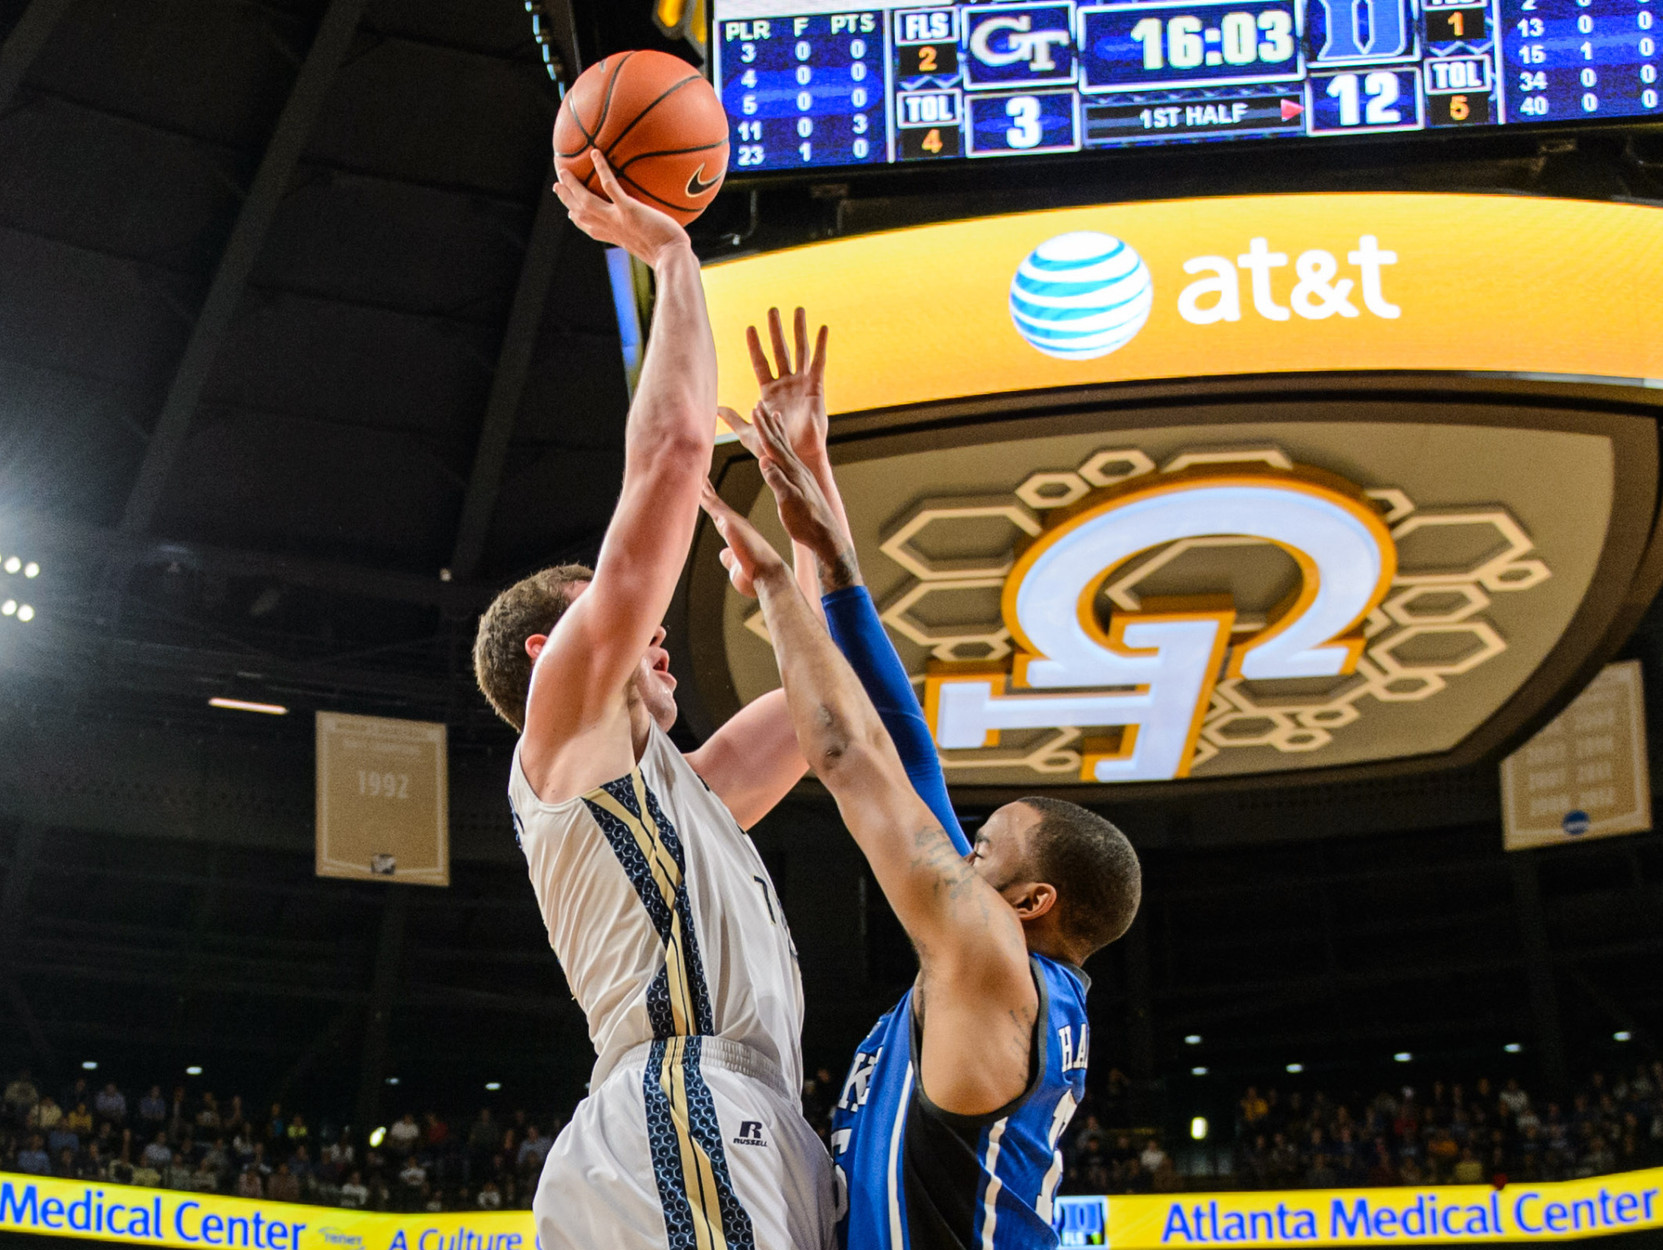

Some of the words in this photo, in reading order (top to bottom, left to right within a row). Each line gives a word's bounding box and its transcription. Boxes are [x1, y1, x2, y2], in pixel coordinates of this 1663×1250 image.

[725, 20, 771, 42] PLR
[793, 17, 810, 38] F
[831, 13, 875, 35] PTS
[905, 12, 949, 41] FLS
[1447, 11, 1464, 37] 1
[1517, 17, 1545, 38] 13
[1577, 14, 1594, 34] 0
[1637, 10, 1653, 30] 0
[741, 43, 757, 63] 3
[795, 41, 811, 61] 0
[850, 39, 867, 59] 0
[970, 15, 1070, 71] GT
[1130, 10, 1294, 70] 16:03
[1518, 45, 1547, 64] 15
[1580, 41, 1593, 61] 1
[1639, 37, 1655, 57] 0
[918, 46, 938, 72] 2
[740, 69, 758, 89] 4
[795, 65, 812, 85] 0
[851, 61, 867, 82] 0
[1432, 61, 1482, 89] TOL
[1519, 71, 1548, 91] 34
[1580, 68, 1597, 88] 0
[1640, 64, 1657, 84] 0
[742, 95, 758, 115] 5
[796, 91, 813, 112] 0
[851, 88, 868, 108] 0
[905, 95, 953, 123] TOL
[1326, 71, 1401, 126] 12
[1449, 95, 1470, 121] 5
[1520, 96, 1549, 116] 40
[1581, 92, 1599, 113] 0
[1642, 88, 1658, 109] 0
[738, 120, 762, 142] 11
[797, 117, 813, 138] 0
[852, 113, 869, 134] 3
[1005, 95, 1044, 149] 3
[1140, 107, 1181, 129] 1ST
[1186, 103, 1248, 126] HALF
[738, 145, 765, 166] 23
[799, 141, 812, 162] 1
[853, 138, 870, 159] 0
[921, 128, 944, 154] 4
[358, 770, 410, 800] 1992
[733, 1138, 768, 1147] RUSSELL
[0, 1182, 163, 1238] Medical
[1161, 1201, 1318, 1243] Atlanta
[1330, 1191, 1503, 1239] Medical
[1514, 1186, 1659, 1233] Center
